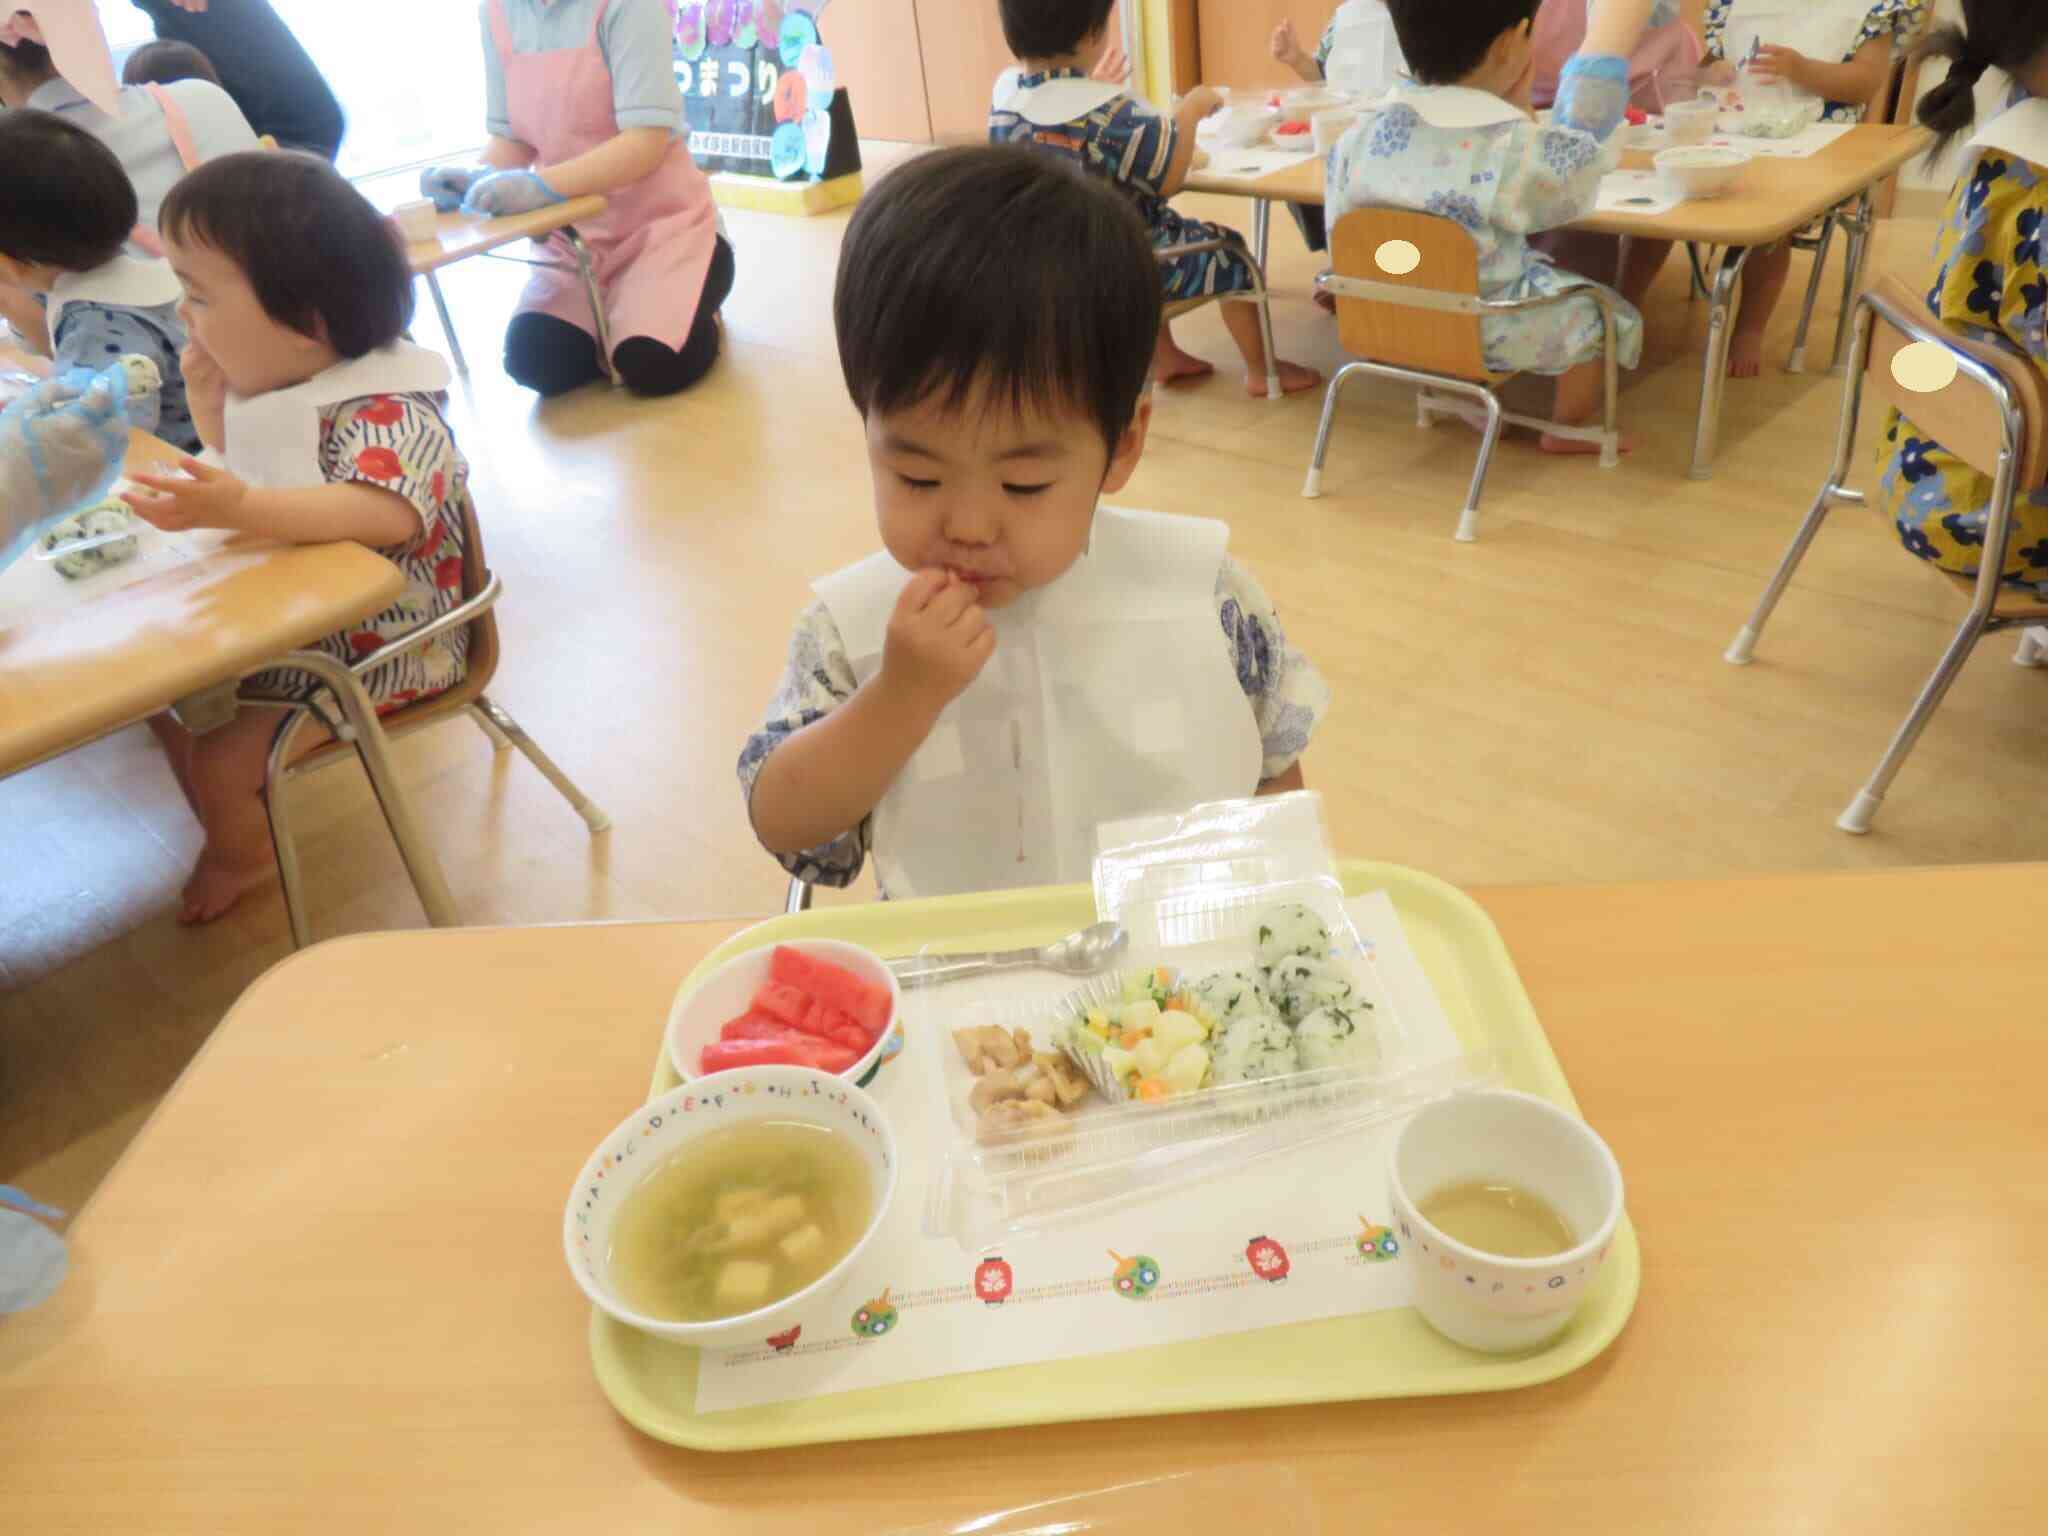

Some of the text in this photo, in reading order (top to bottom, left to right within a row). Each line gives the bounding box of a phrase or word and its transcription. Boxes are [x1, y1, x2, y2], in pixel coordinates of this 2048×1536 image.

[672, 57, 778, 105] つまつり
[649, 1116, 663, 1129] D
[684, 1096, 696, 1112] E
